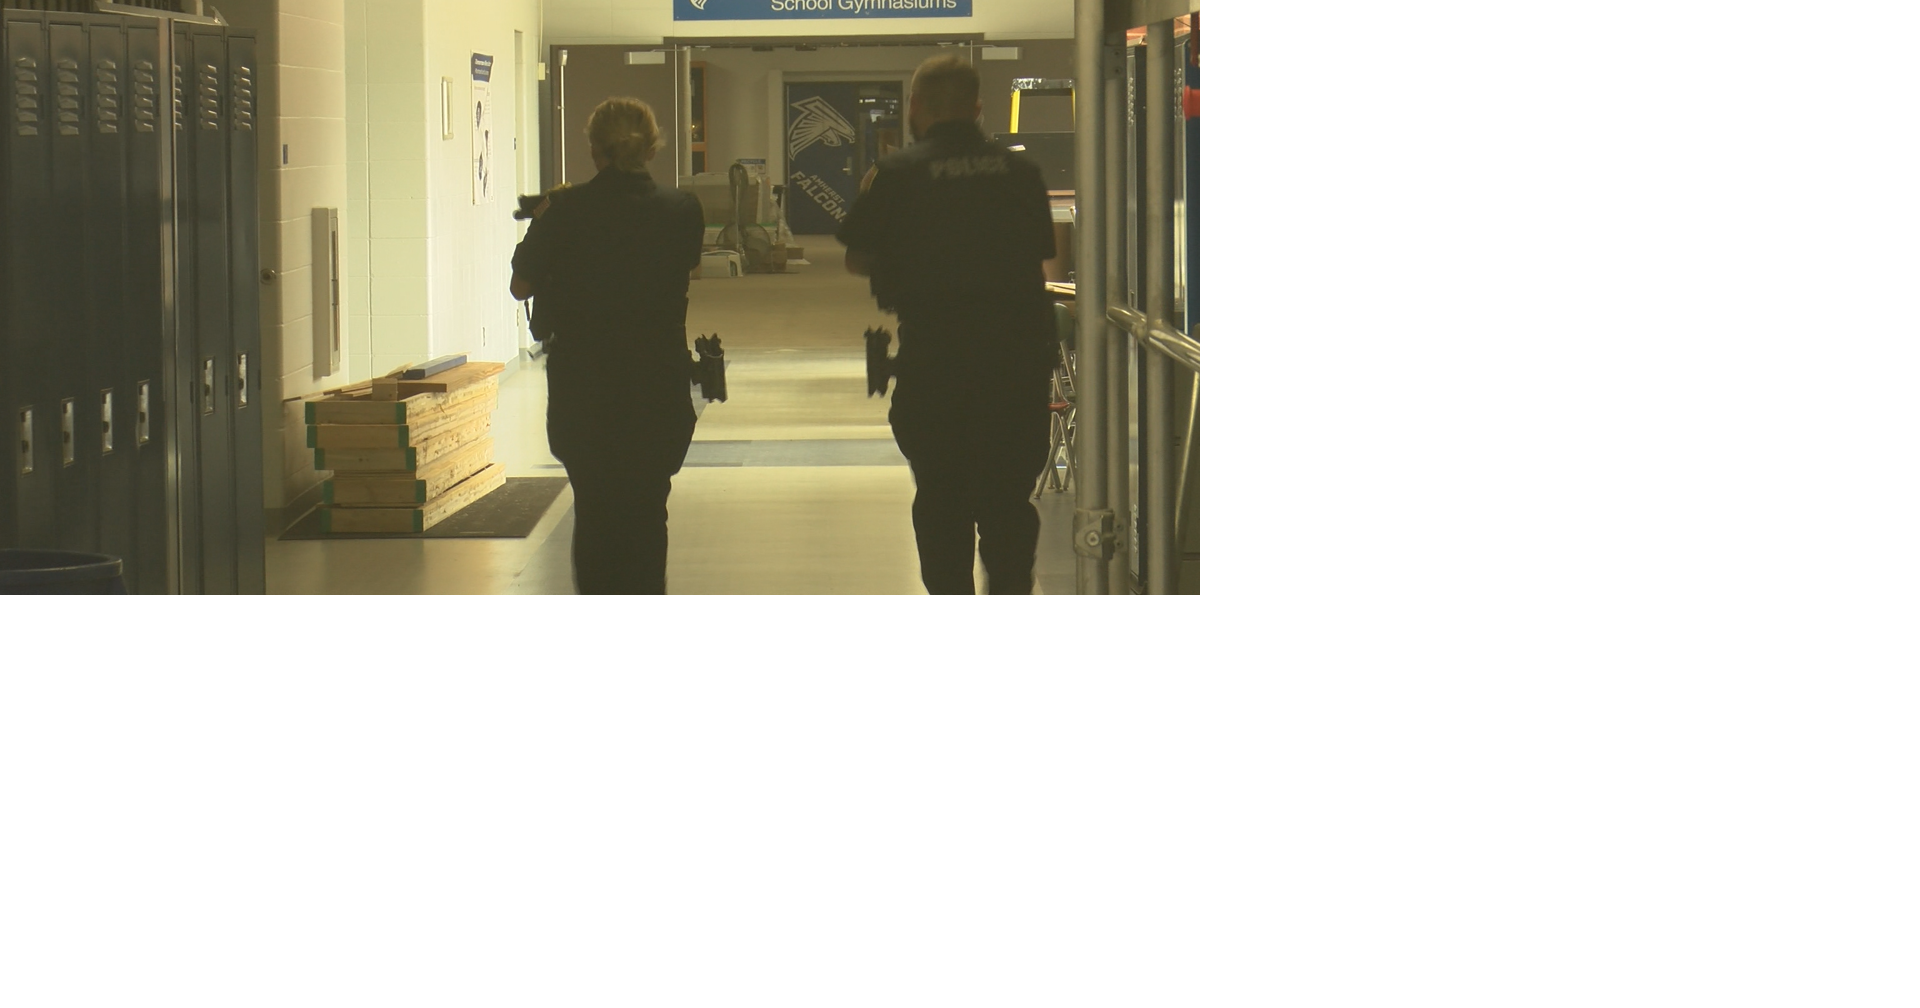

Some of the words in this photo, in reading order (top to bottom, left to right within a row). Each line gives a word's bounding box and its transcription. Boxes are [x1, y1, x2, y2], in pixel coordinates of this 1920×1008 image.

[771, 0, 833, 11] School
[838, 0, 958, 14] Gymnasiums
[790, 171, 847, 223] FALCON
[810, 175, 846, 204] AMHERST
